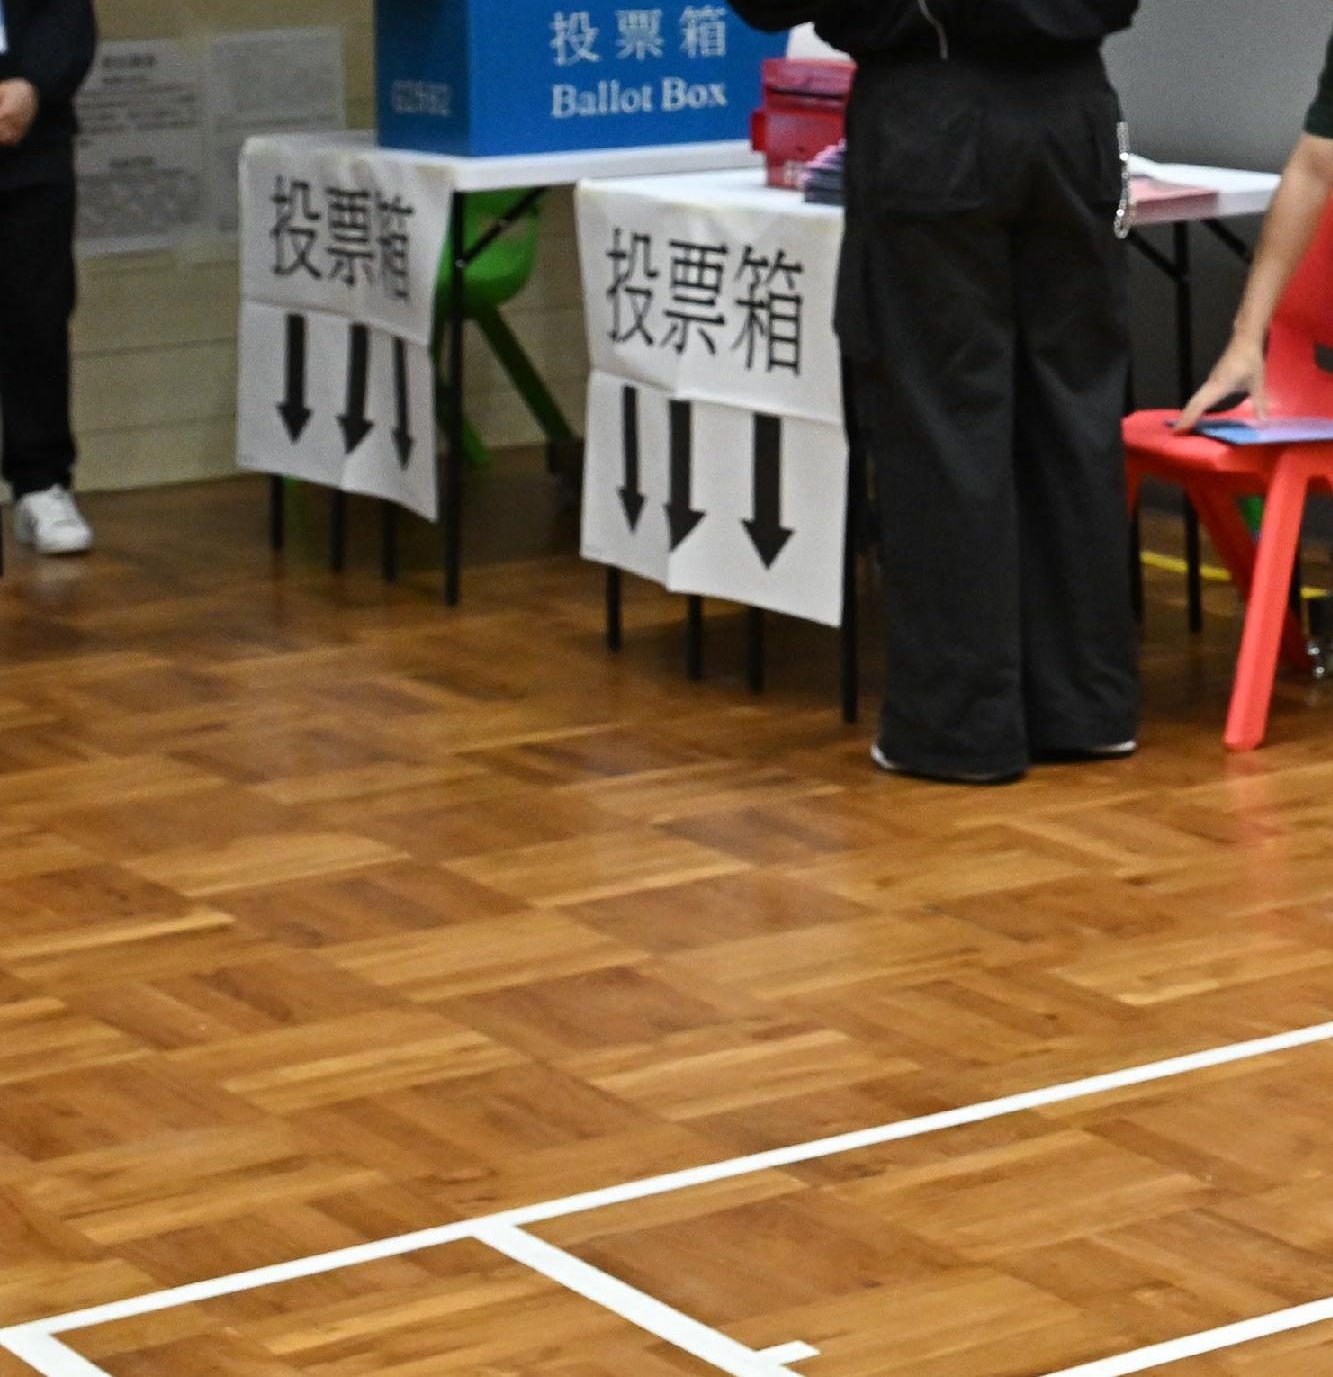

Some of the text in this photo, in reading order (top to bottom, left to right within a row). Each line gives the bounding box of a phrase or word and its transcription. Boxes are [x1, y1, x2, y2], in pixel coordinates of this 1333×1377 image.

[550, 5, 727, 66] 投票箱
[552, 76, 727, 119] Ballot Box
[268, 174, 416, 302] 投票箱
[606, 227, 804, 376] 投票箱
